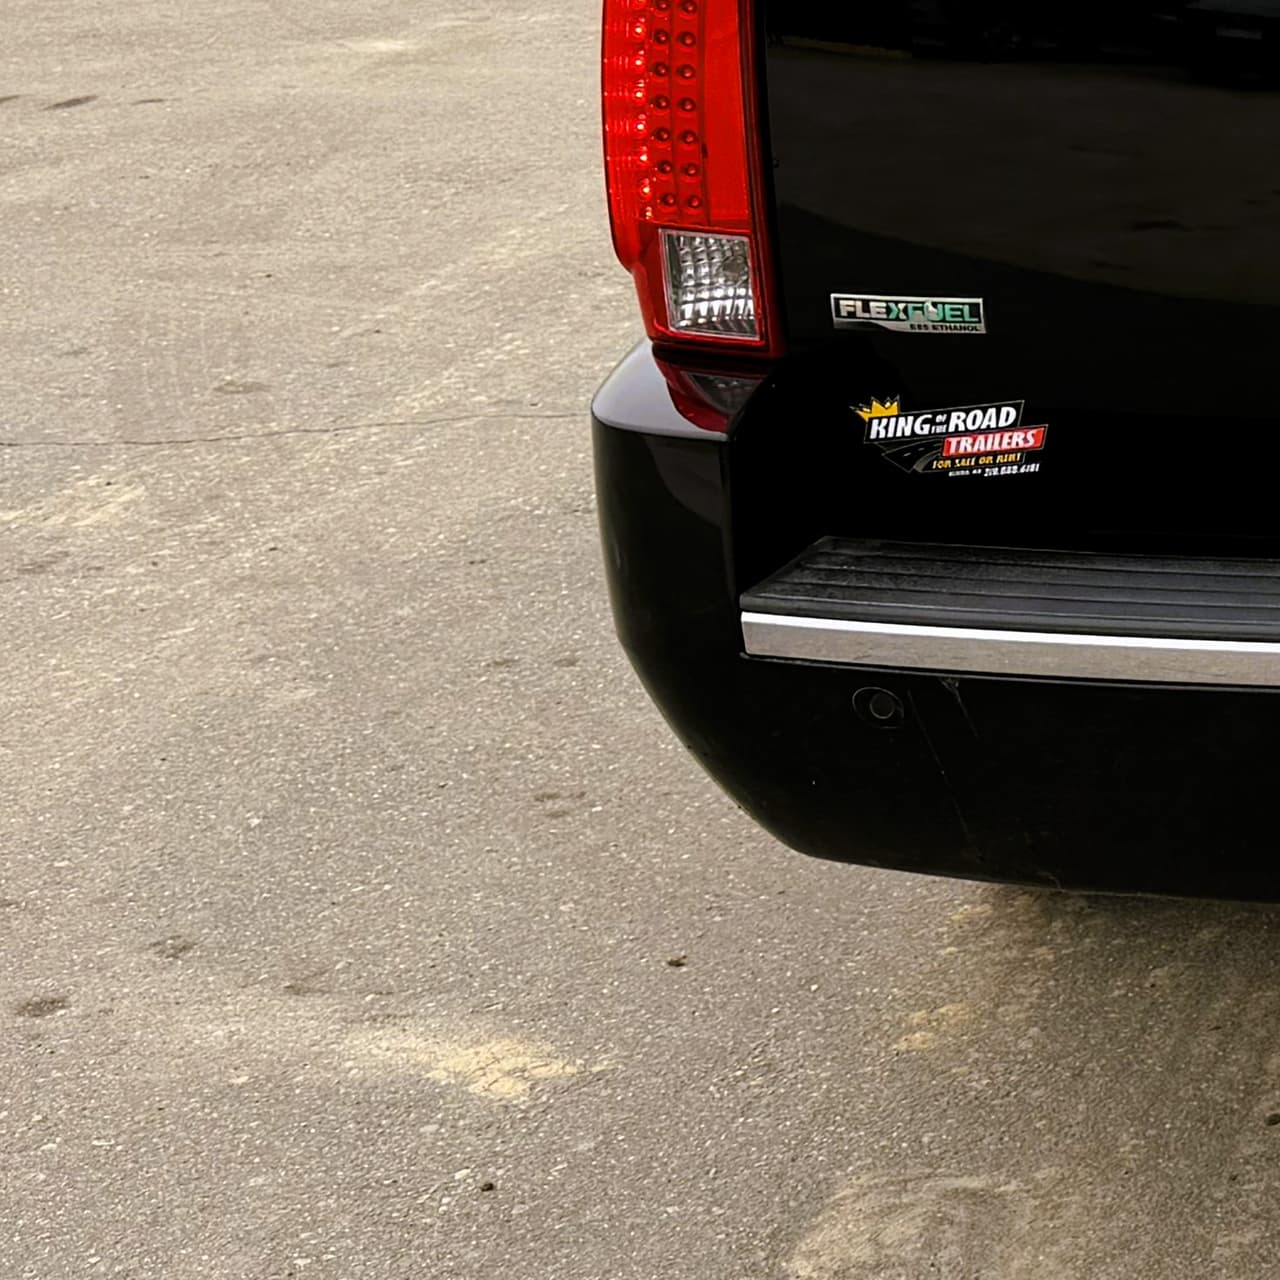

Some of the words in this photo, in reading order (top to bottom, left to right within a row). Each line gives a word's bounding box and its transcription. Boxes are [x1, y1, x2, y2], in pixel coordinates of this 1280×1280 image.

[838, 299, 979, 322] FLEXFUEL
[869, 414, 933, 440] KING
[948, 406, 1017, 433] ROAD
[950, 429, 1036, 454] TRAILERS
